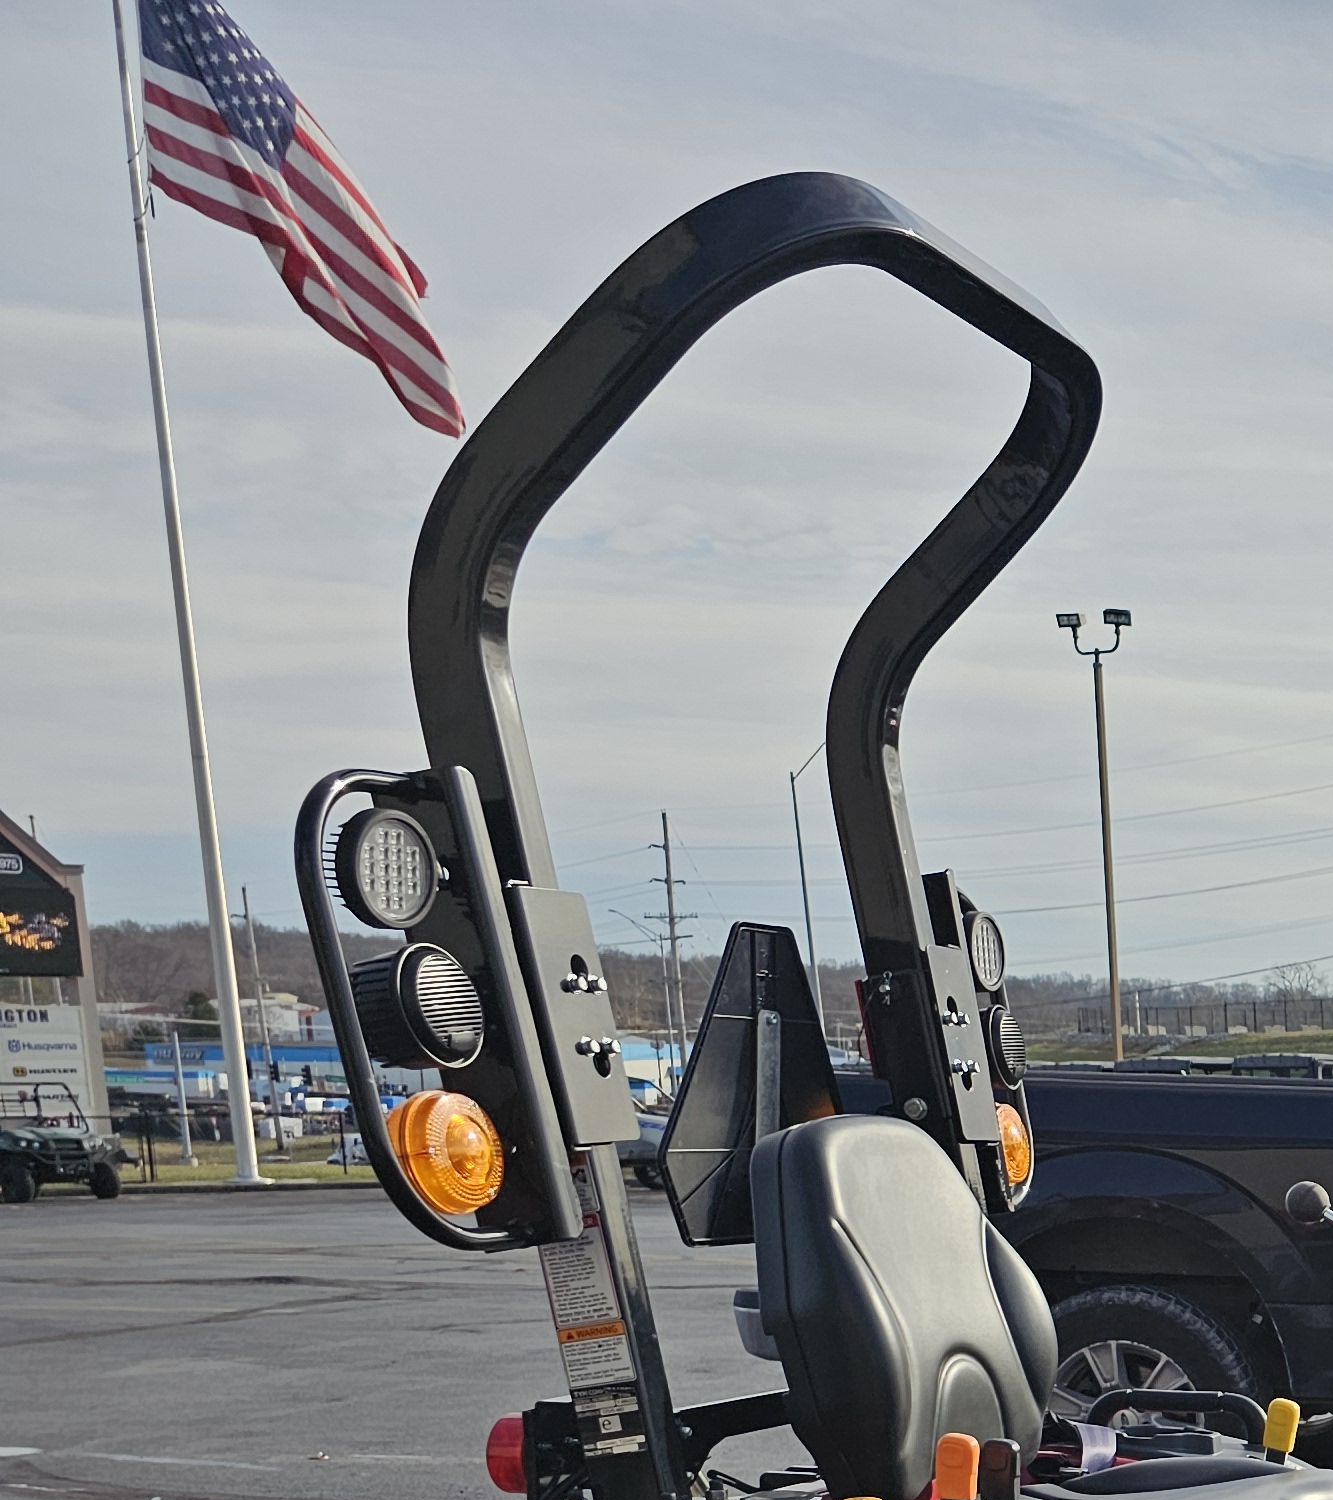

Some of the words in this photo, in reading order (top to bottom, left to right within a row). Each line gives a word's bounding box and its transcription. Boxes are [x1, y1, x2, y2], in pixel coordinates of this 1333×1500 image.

[22, 1042, 77, 1051] Husqvarna
[576, 1325, 618, 1338] WARNING
[602, 1419, 612, 1430] e
